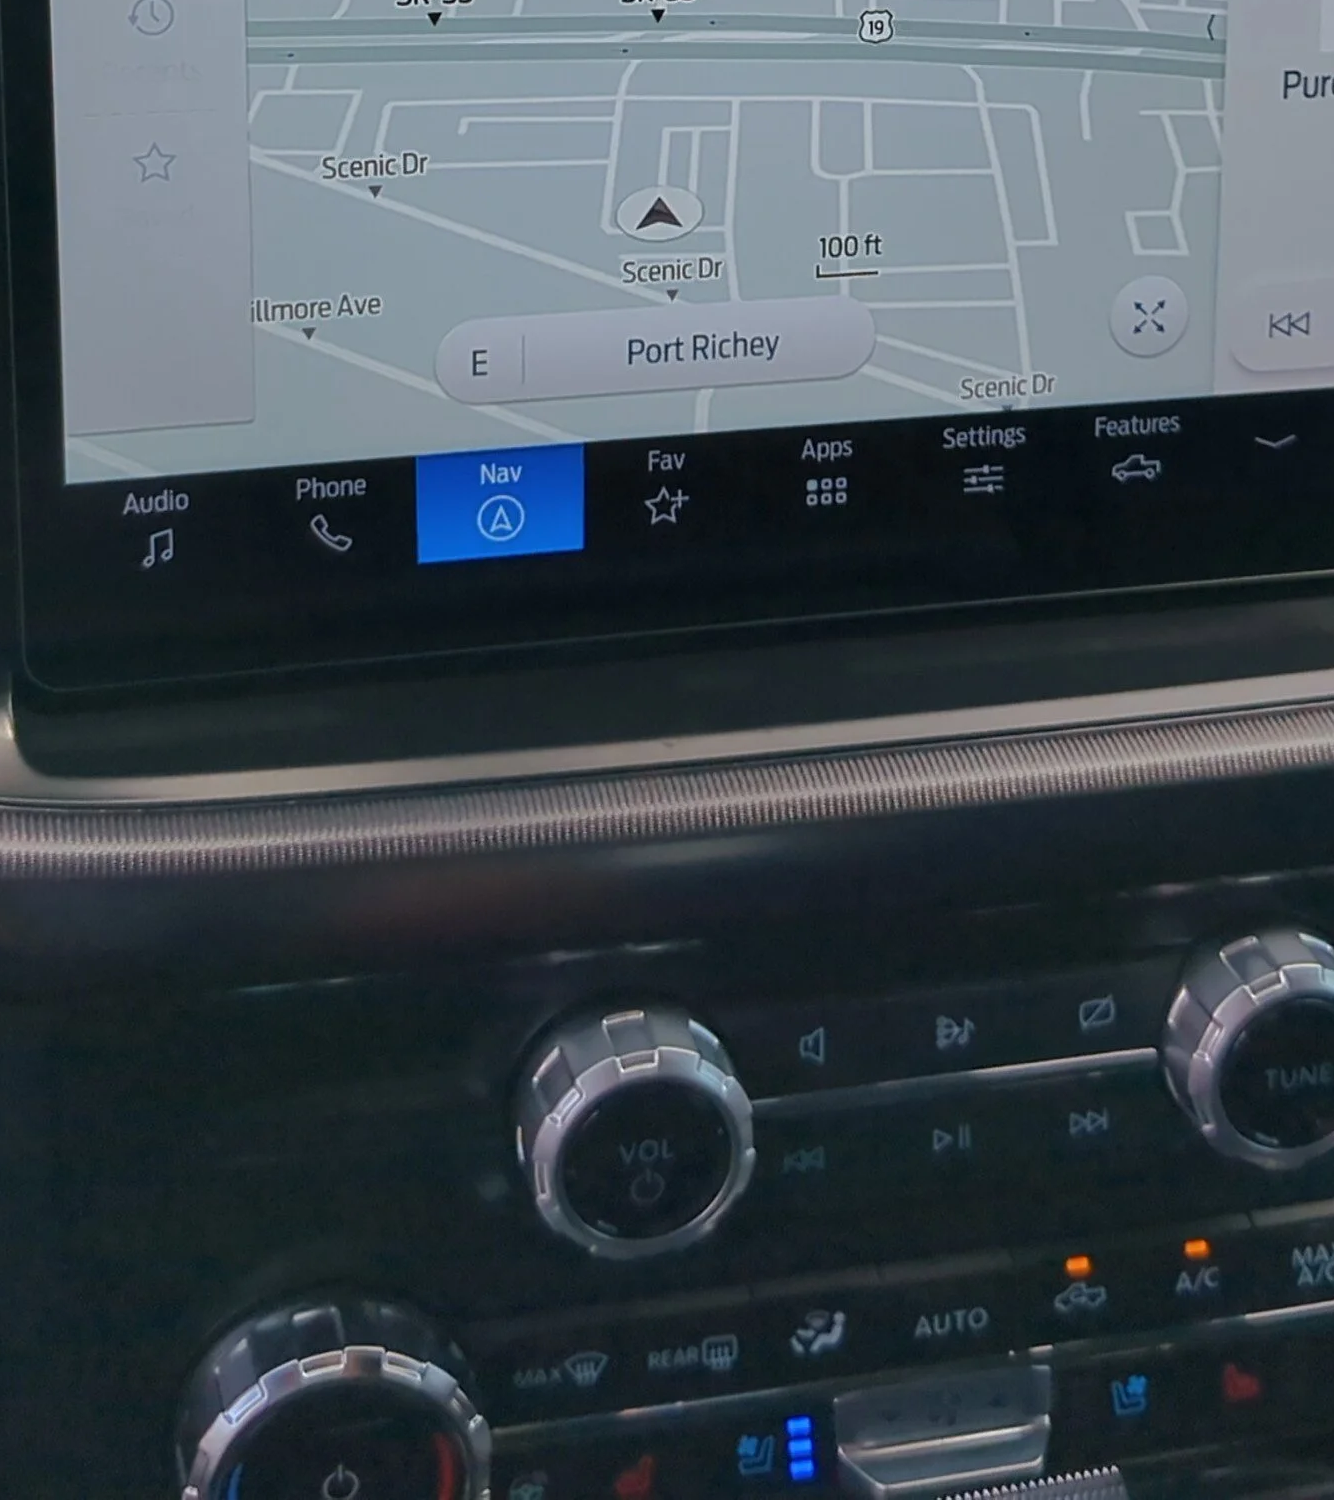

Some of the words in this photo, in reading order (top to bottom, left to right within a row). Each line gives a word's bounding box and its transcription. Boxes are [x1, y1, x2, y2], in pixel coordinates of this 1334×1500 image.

[868, 19, 885, 36] 19
[322, 154, 397, 181] Scenic
[402, 152, 429, 176] Dr
[818, 235, 858, 260] 100
[864, 234, 883, 258] ft
[622, 260, 693, 284] Scenic
[699, 258, 724, 281] Dr
[250, 298, 332, 324] illmore
[337, 295, 382, 318] Ave
[627, 335, 685, 366] Port
[692, 330, 780, 366] Richey
[472, 350, 488, 377] E
[959, 376, 1026, 399] Scenic
[1031, 373, 1055, 396] Dr
[942, 424, 1026, 451] Settings
[1094, 413, 1181, 438] Features
[647, 450, 685, 471] Fav
[801, 437, 853, 463] Apps
[480, 463, 523, 485] Nav
[296, 476, 367, 501] Phone
[123, 489, 189, 516] Audio
[1265, 1062, 1333, 1089] TUNE
[619, 1140, 674, 1165] VOL
[1176, 1268, 1220, 1295] A/C
[914, 1307, 988, 1339] AUTO
[647, 1344, 700, 1371] REAR
